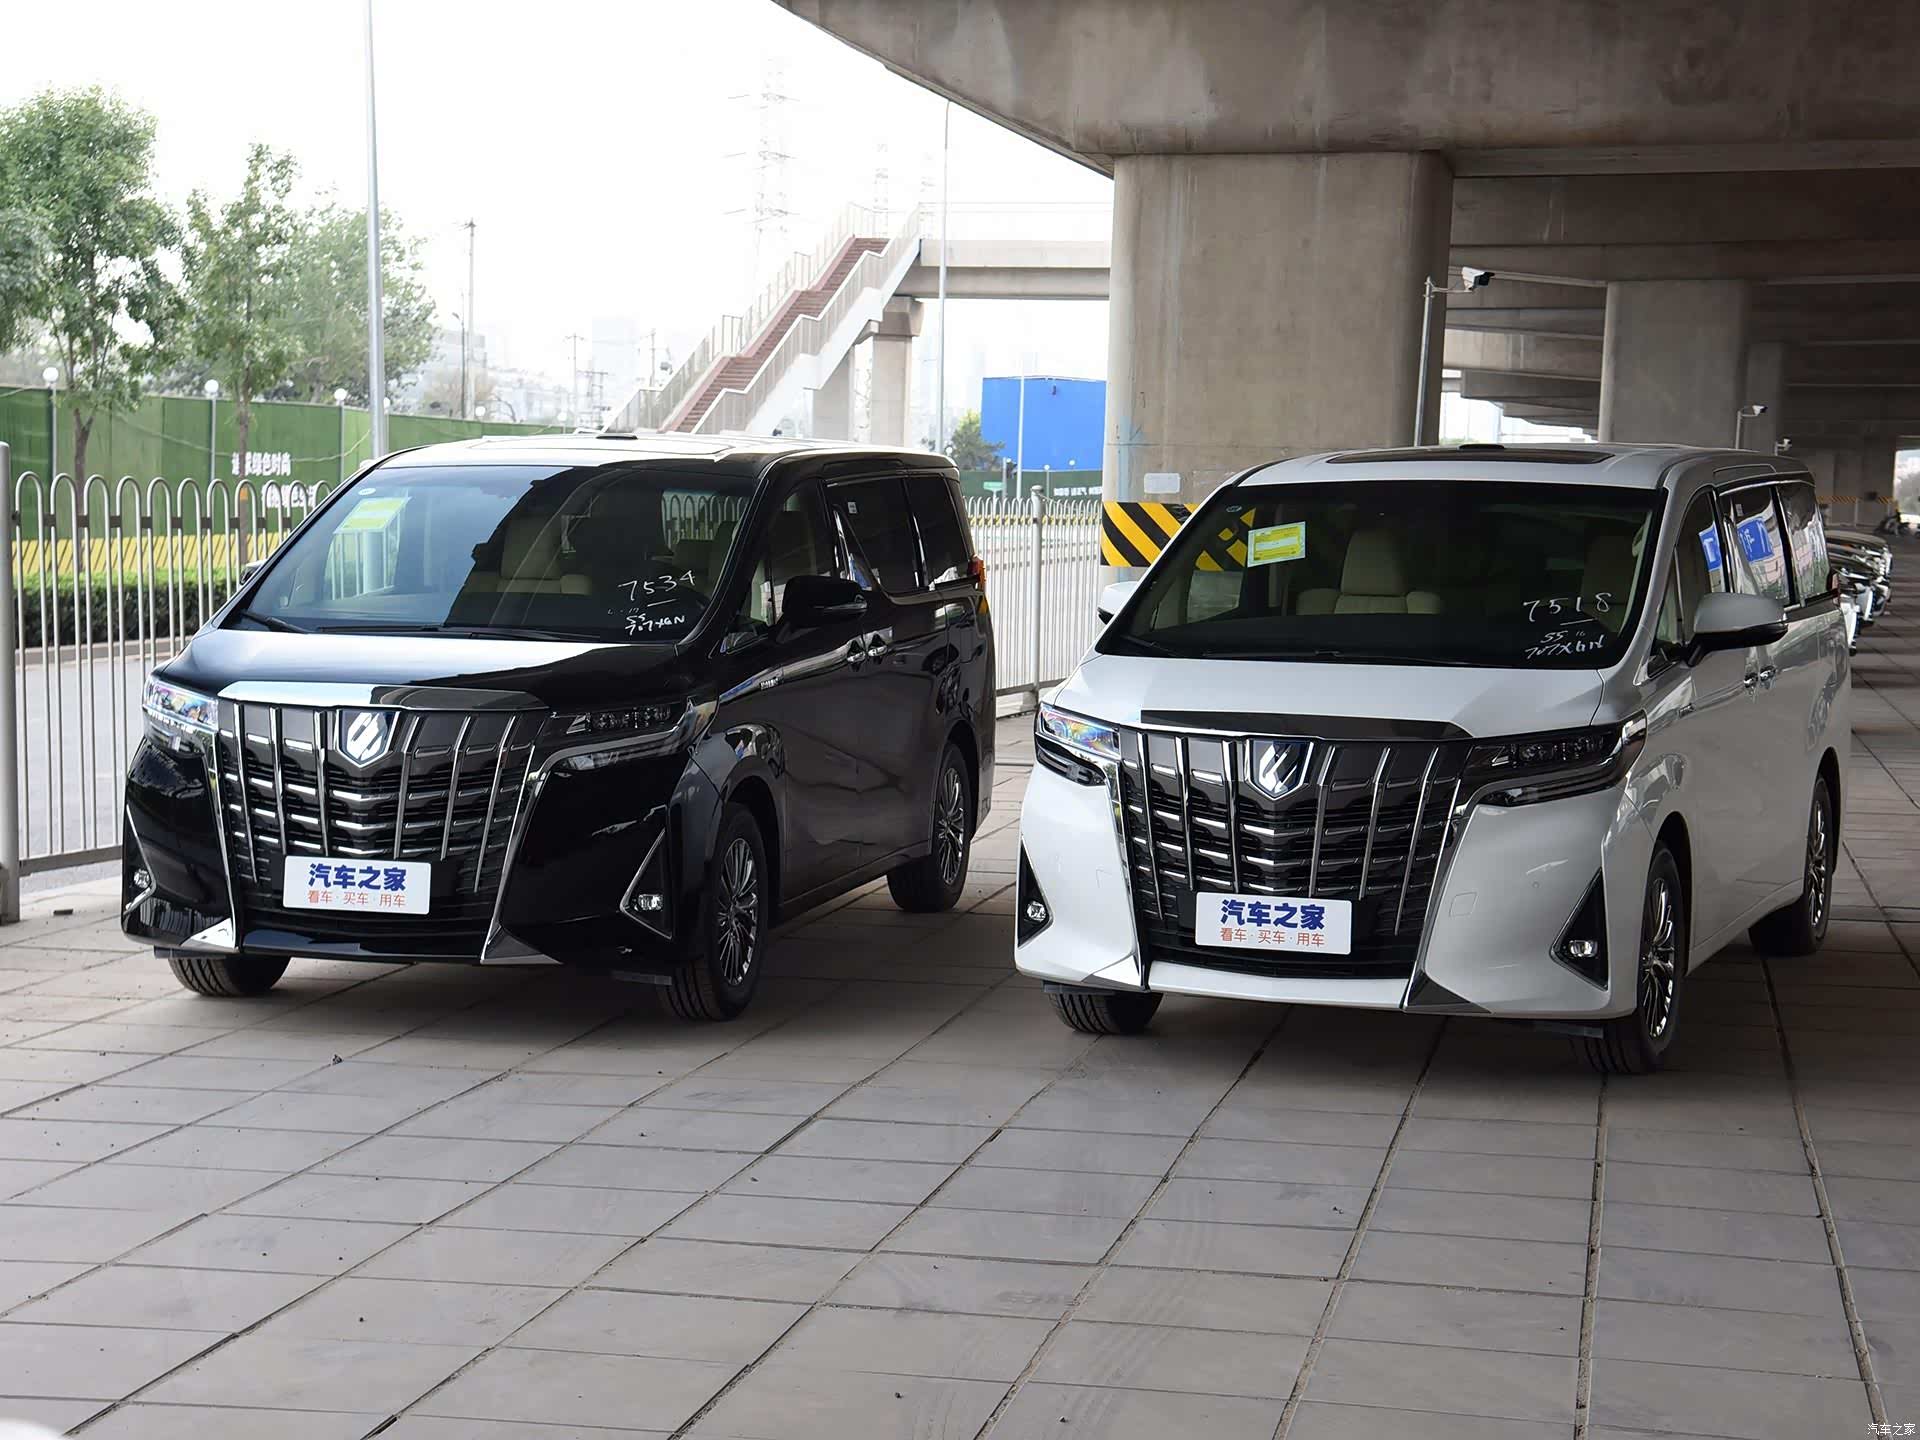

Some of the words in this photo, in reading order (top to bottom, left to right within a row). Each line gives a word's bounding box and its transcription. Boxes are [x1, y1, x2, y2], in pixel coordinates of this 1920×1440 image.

[617, 570, 696, 601] 7534
[1522, 592, 1612, 622] 7518
[308, 862, 407, 892] 汽车之家
[307, 890, 332, 904] 看车
[343, 891, 369, 906] 买车
[379, 893, 406, 908] 用车
[1220, 899, 1325, 931] 汽车之家
[1220, 927, 1247, 943] 看车
[1258, 929, 1286, 945] 买车
[1296, 931, 1325, 948] 用车
